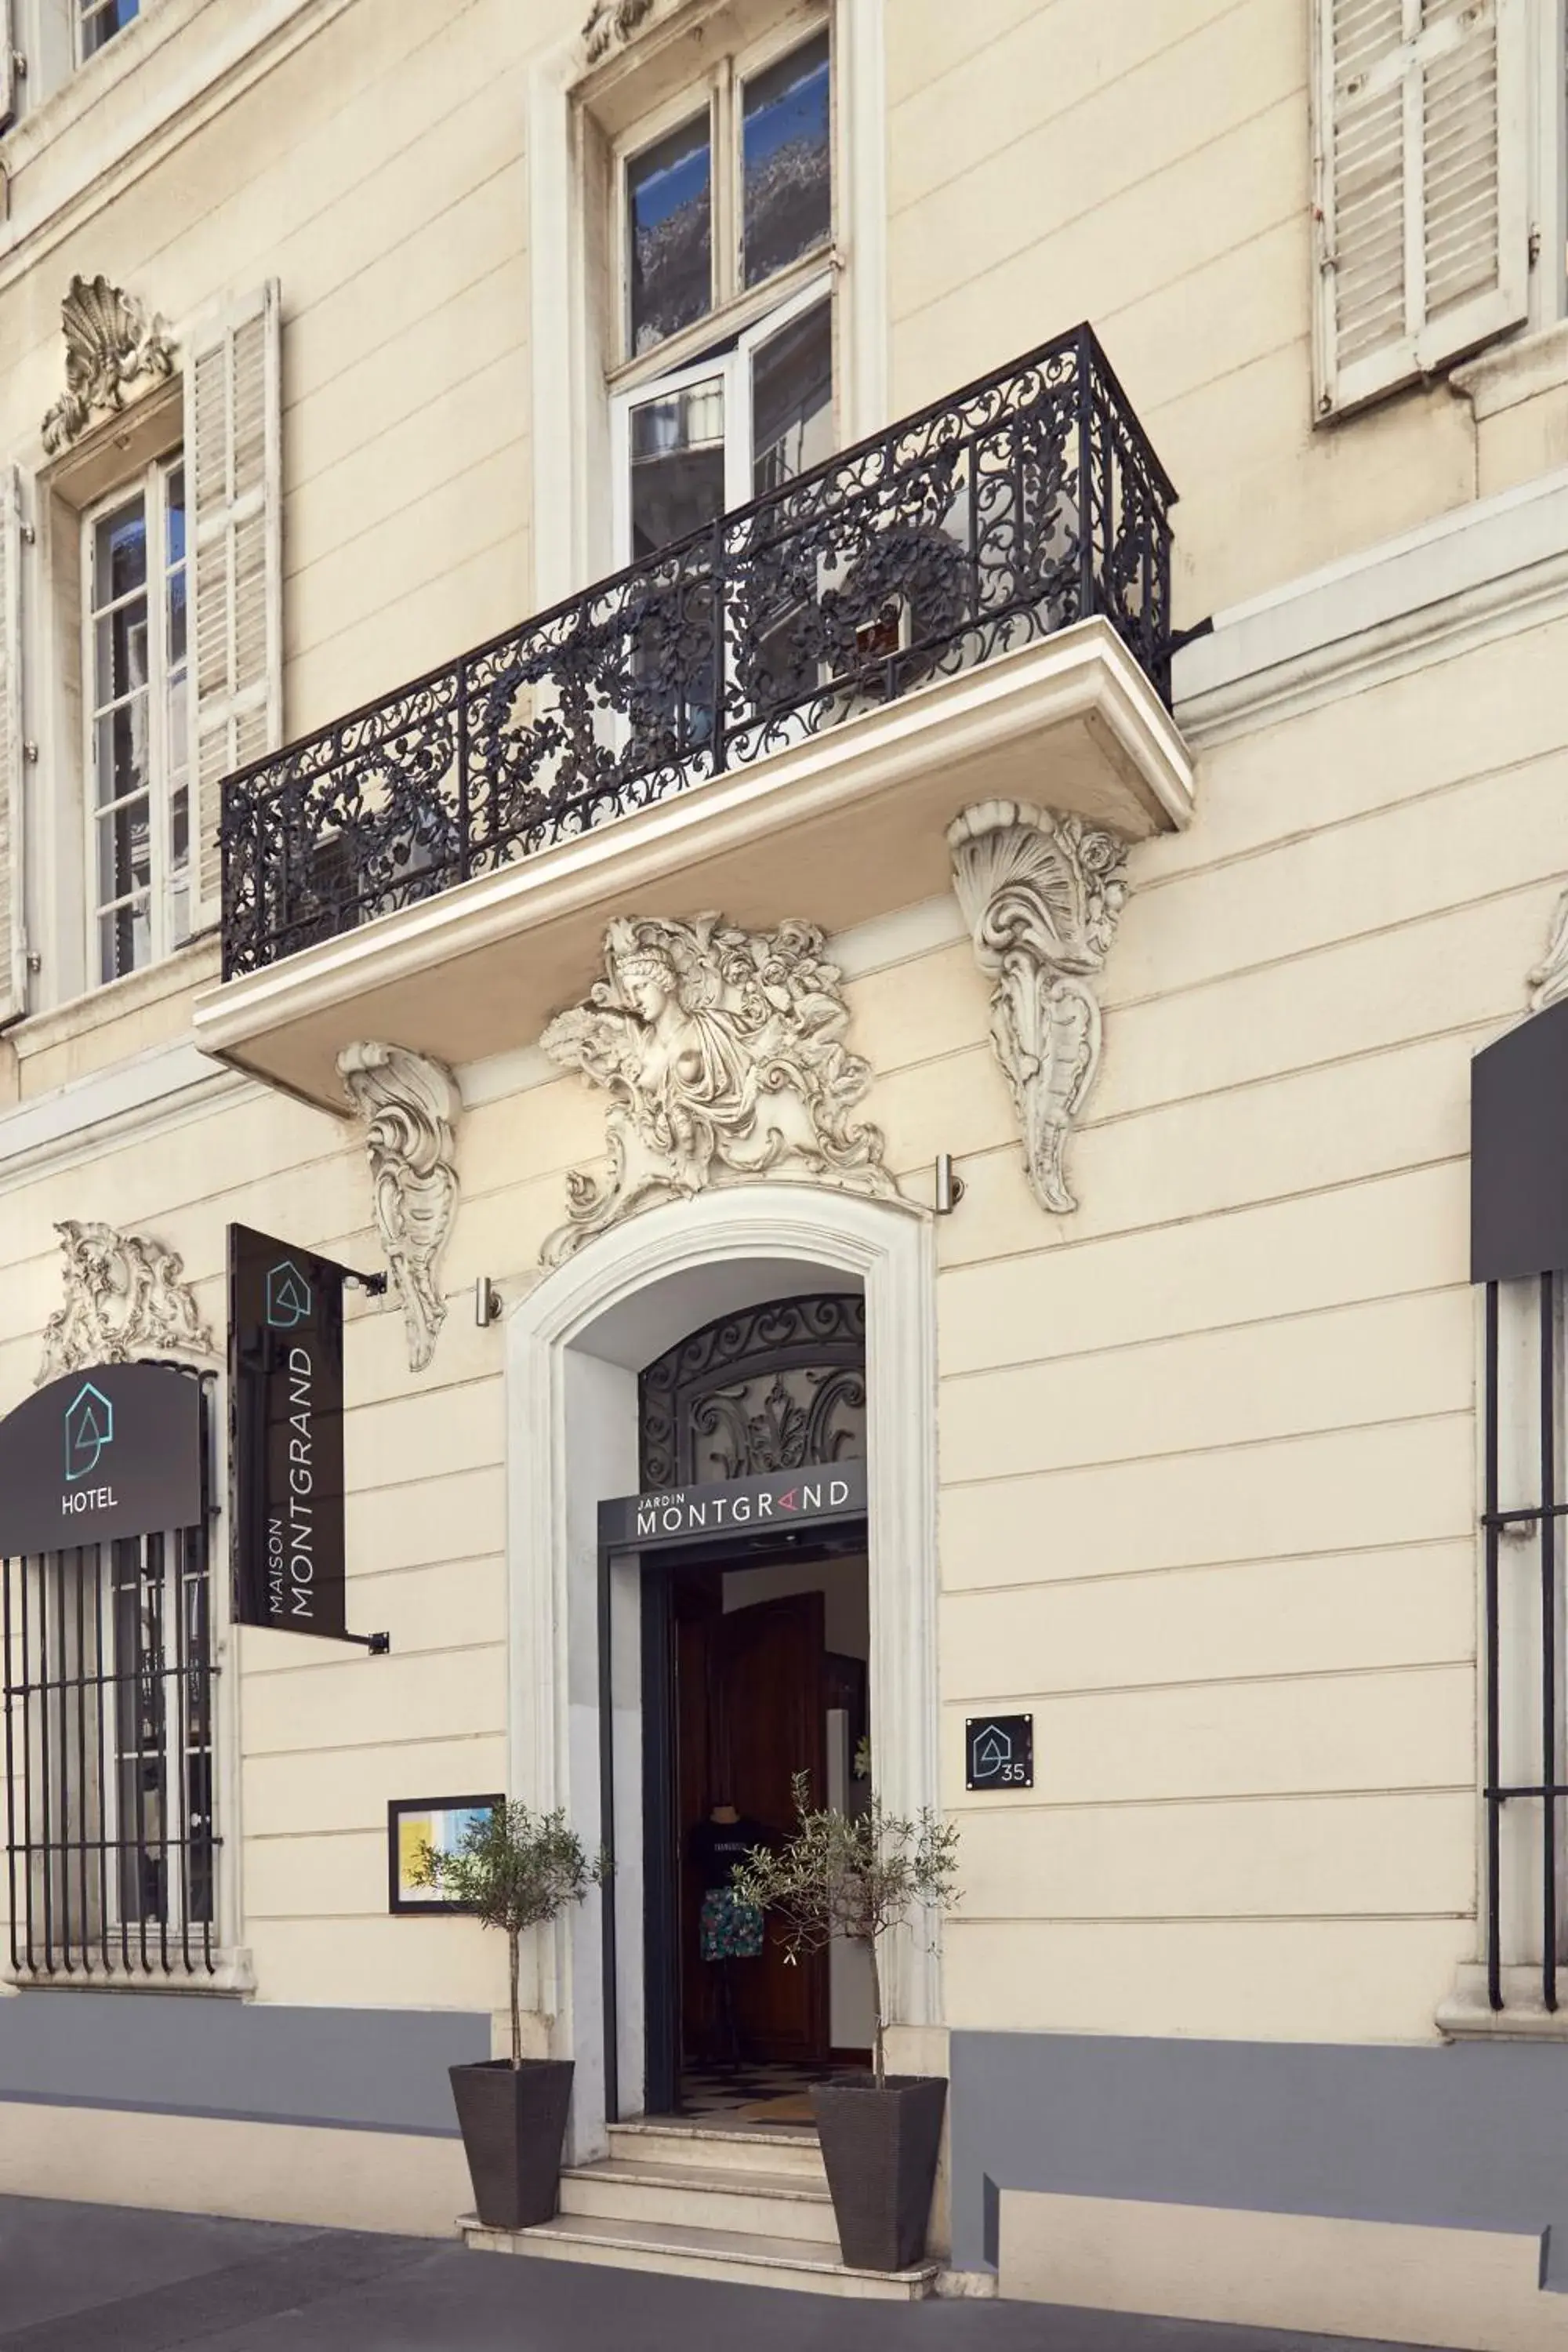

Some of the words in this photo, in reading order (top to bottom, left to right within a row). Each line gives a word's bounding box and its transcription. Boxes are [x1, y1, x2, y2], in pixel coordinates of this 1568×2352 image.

[62, 1486, 118, 1515] HOTEL
[289, 1348, 313, 1617] MONTGRAND
[637, 1493, 685, 1511] JARDIN
[637, 1481, 848, 1535] MONTGRAND
[269, 1519, 283, 1613] MAISON
[1001, 1763, 1025, 1781] 35
